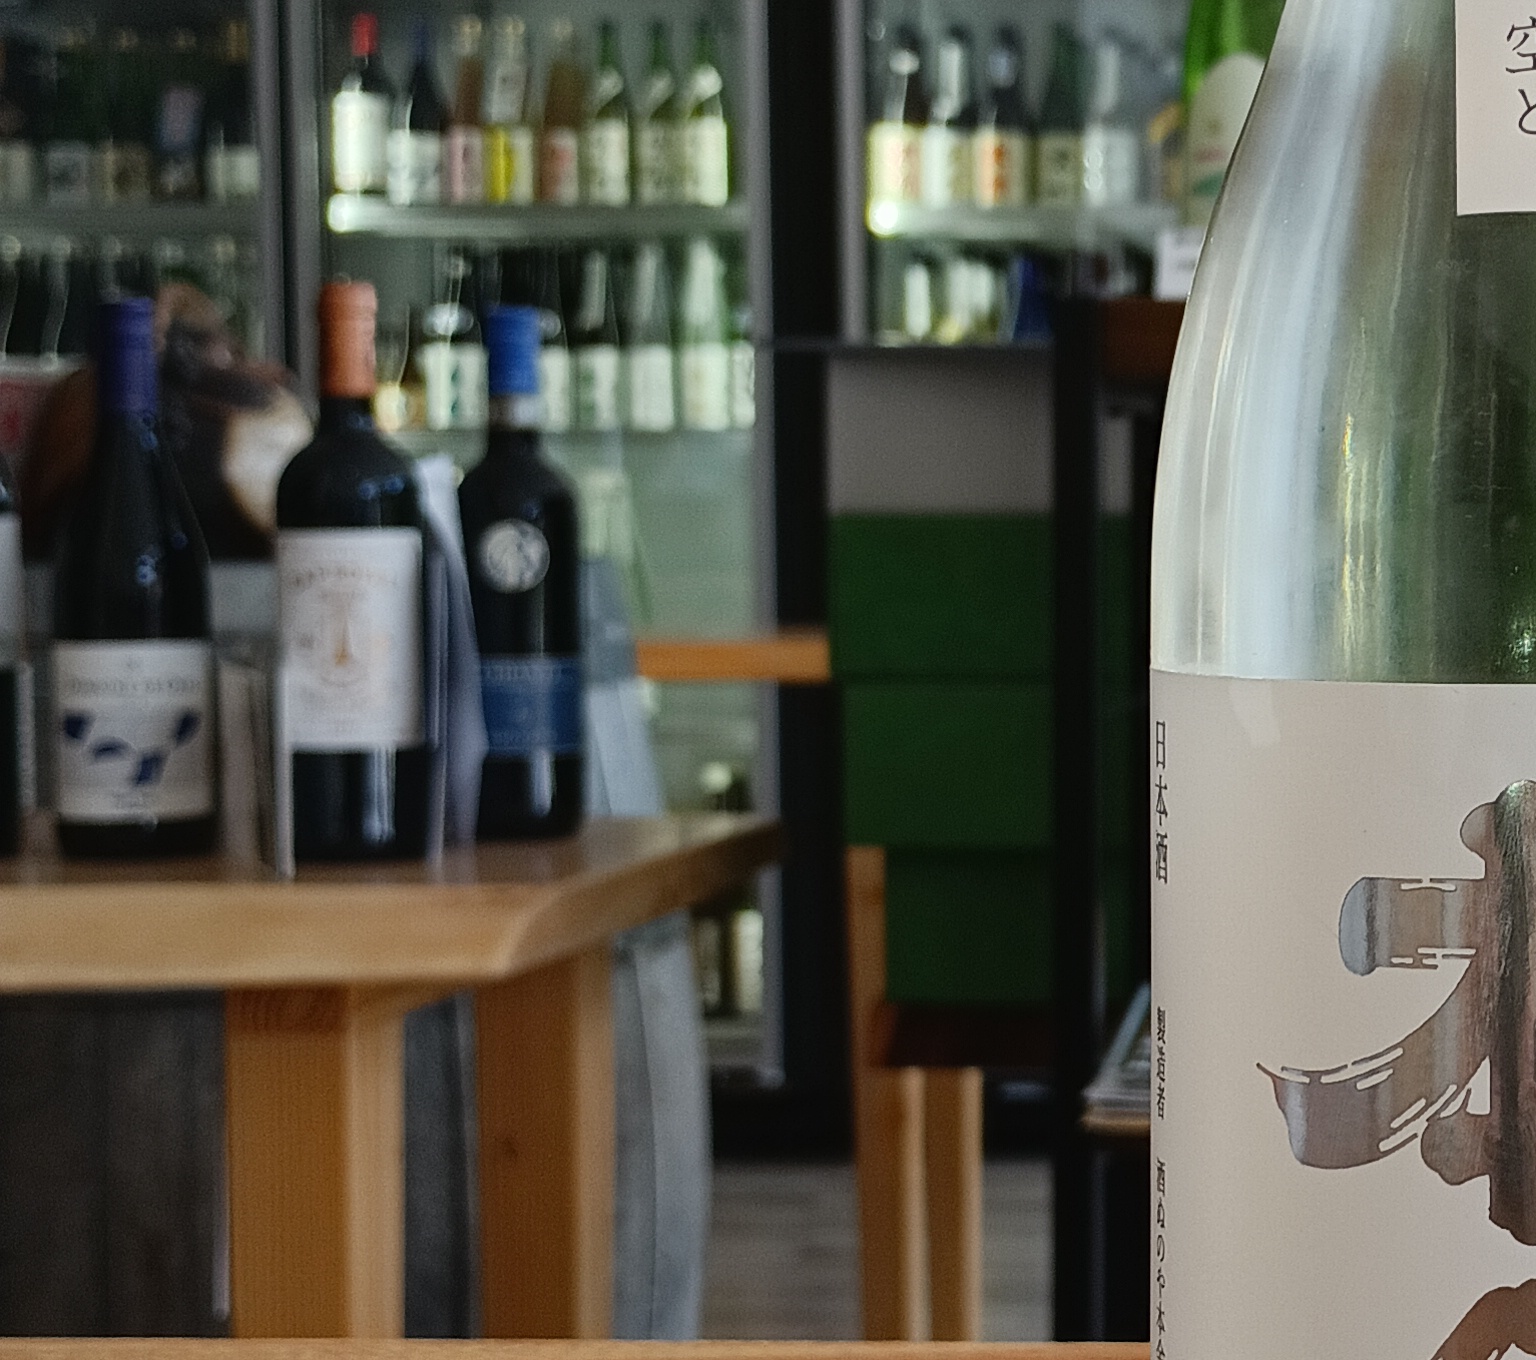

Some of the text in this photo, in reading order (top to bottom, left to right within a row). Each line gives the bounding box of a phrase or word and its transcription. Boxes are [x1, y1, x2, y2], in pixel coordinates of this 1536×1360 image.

[1154, 720, 1169, 885] 日本酒
[1155, 1005, 1167, 1121] 製造者
